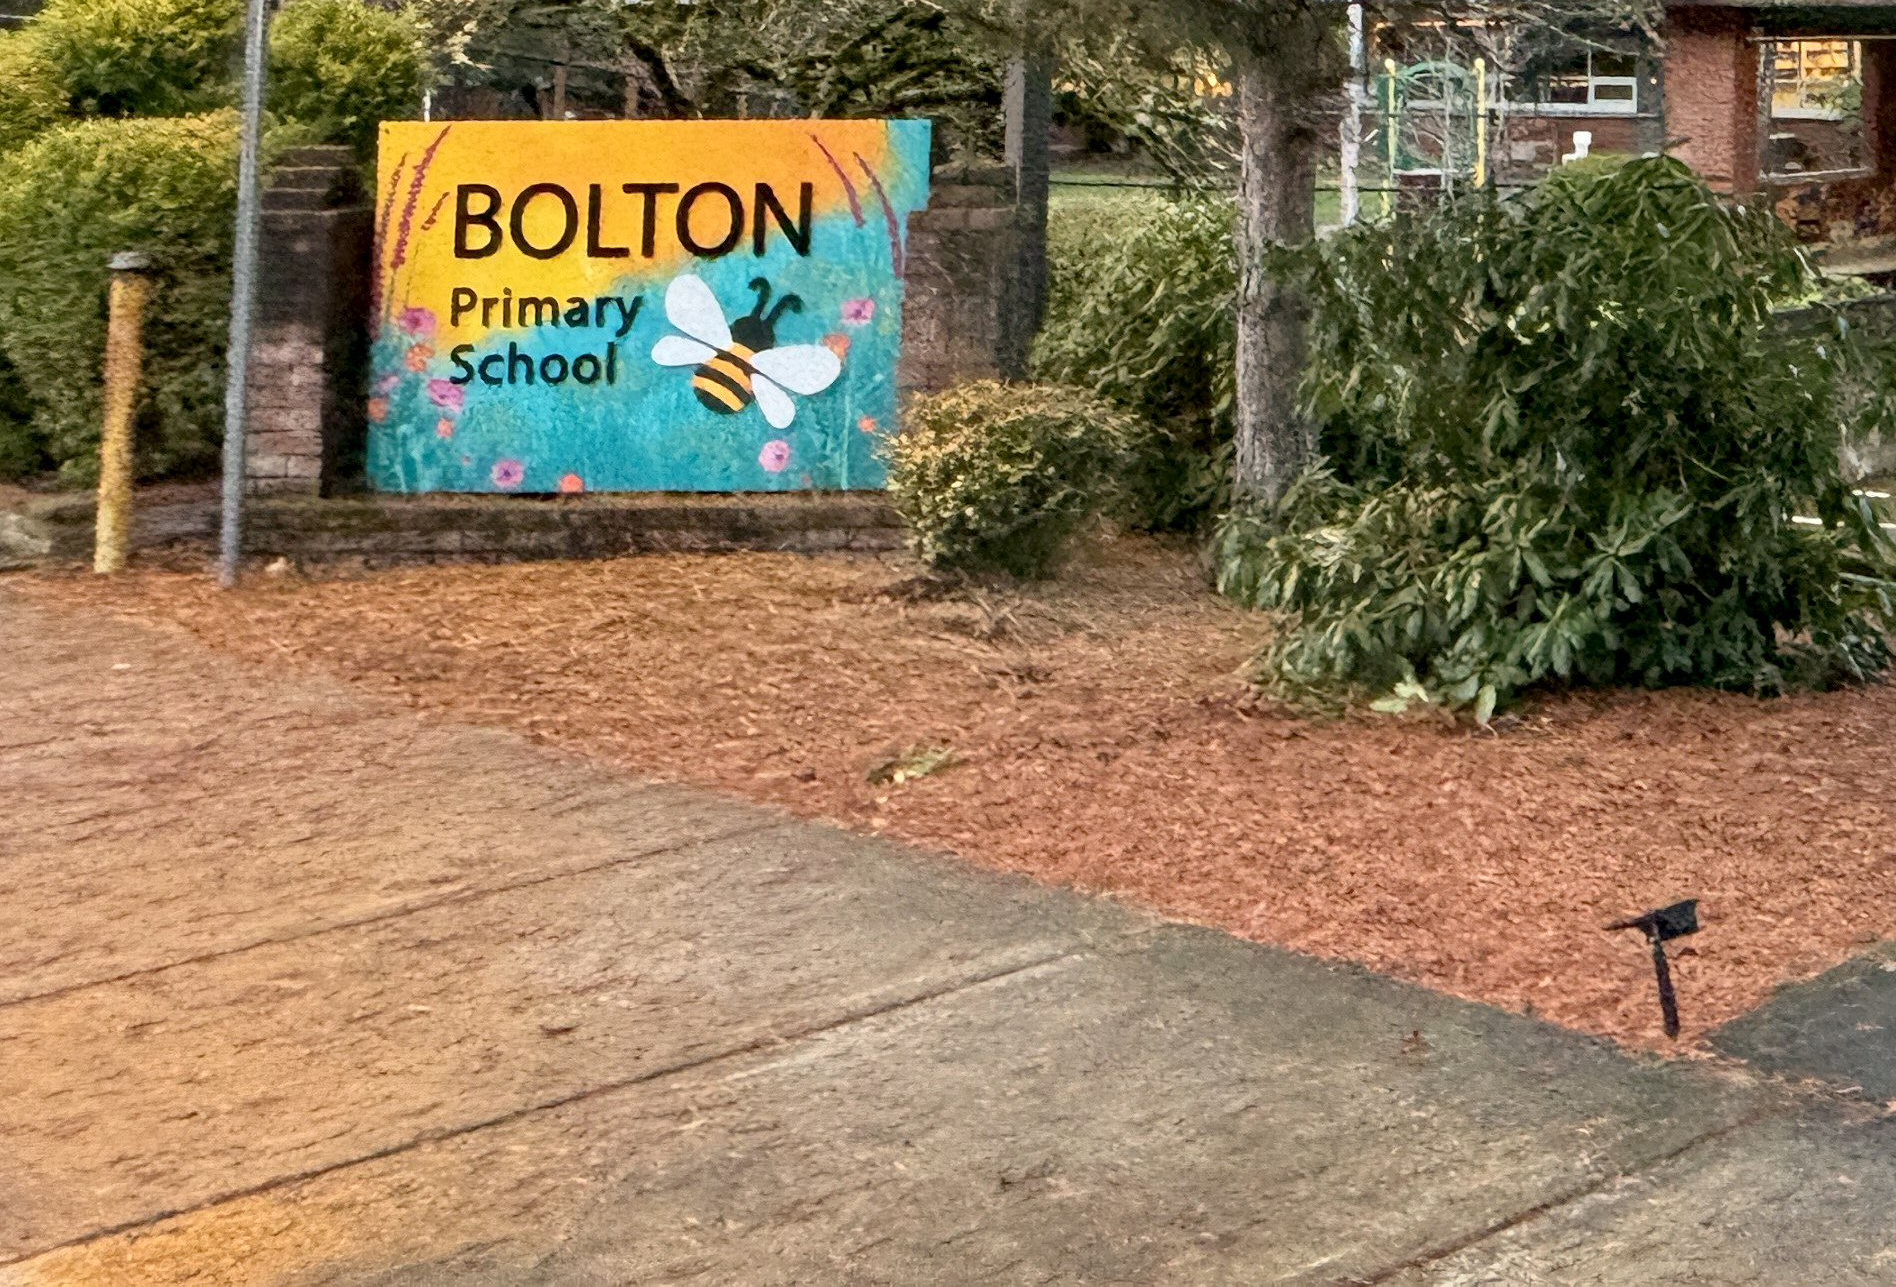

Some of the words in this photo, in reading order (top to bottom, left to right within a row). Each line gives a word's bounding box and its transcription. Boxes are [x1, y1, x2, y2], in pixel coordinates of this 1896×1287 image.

[452, 181, 813, 260] BOLTON
[450, 286, 644, 338] Primary
[449, 341, 618, 386] School
